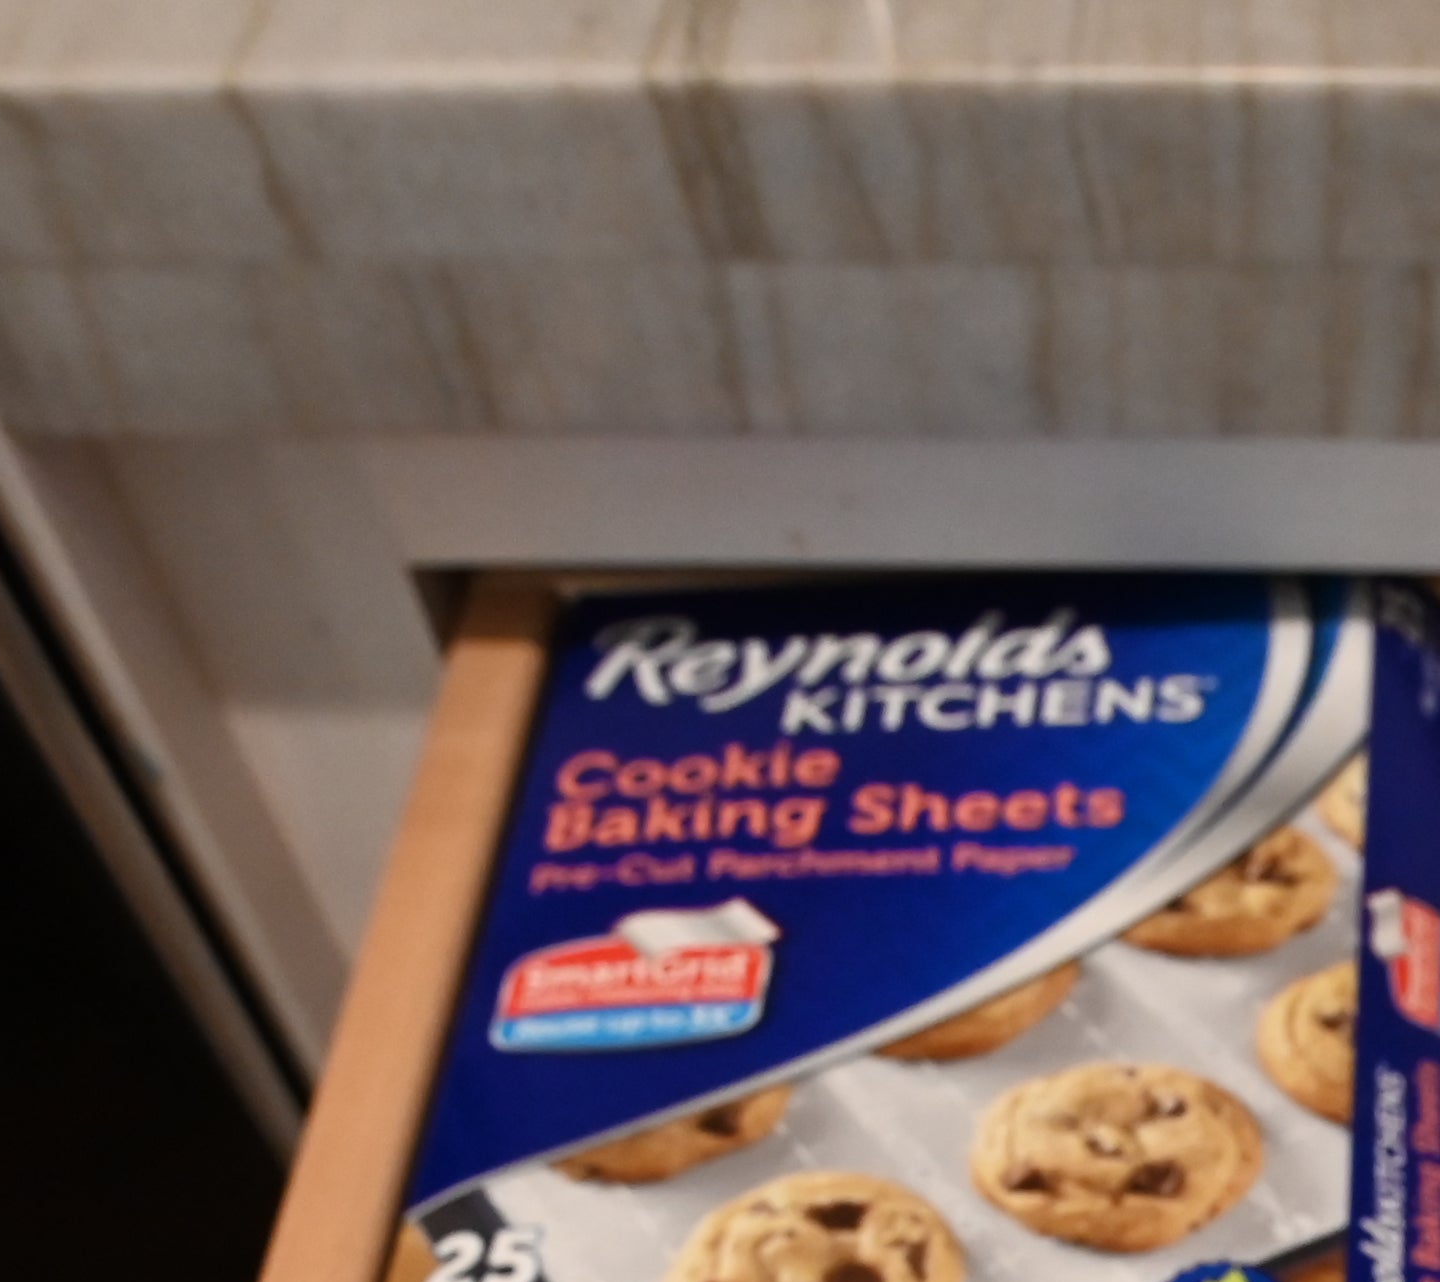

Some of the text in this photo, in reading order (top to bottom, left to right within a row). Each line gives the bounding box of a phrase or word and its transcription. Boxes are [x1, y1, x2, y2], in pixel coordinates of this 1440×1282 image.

[586, 609, 1112, 713] Reynolds
[780, 676, 1207, 735] KITCHENS
[557, 744, 840, 801] Cookie
[543, 784, 1124, 853] Baking Sheets
[708, 845, 940, 880] Parchment
[951, 841, 1076, 876] Paper
